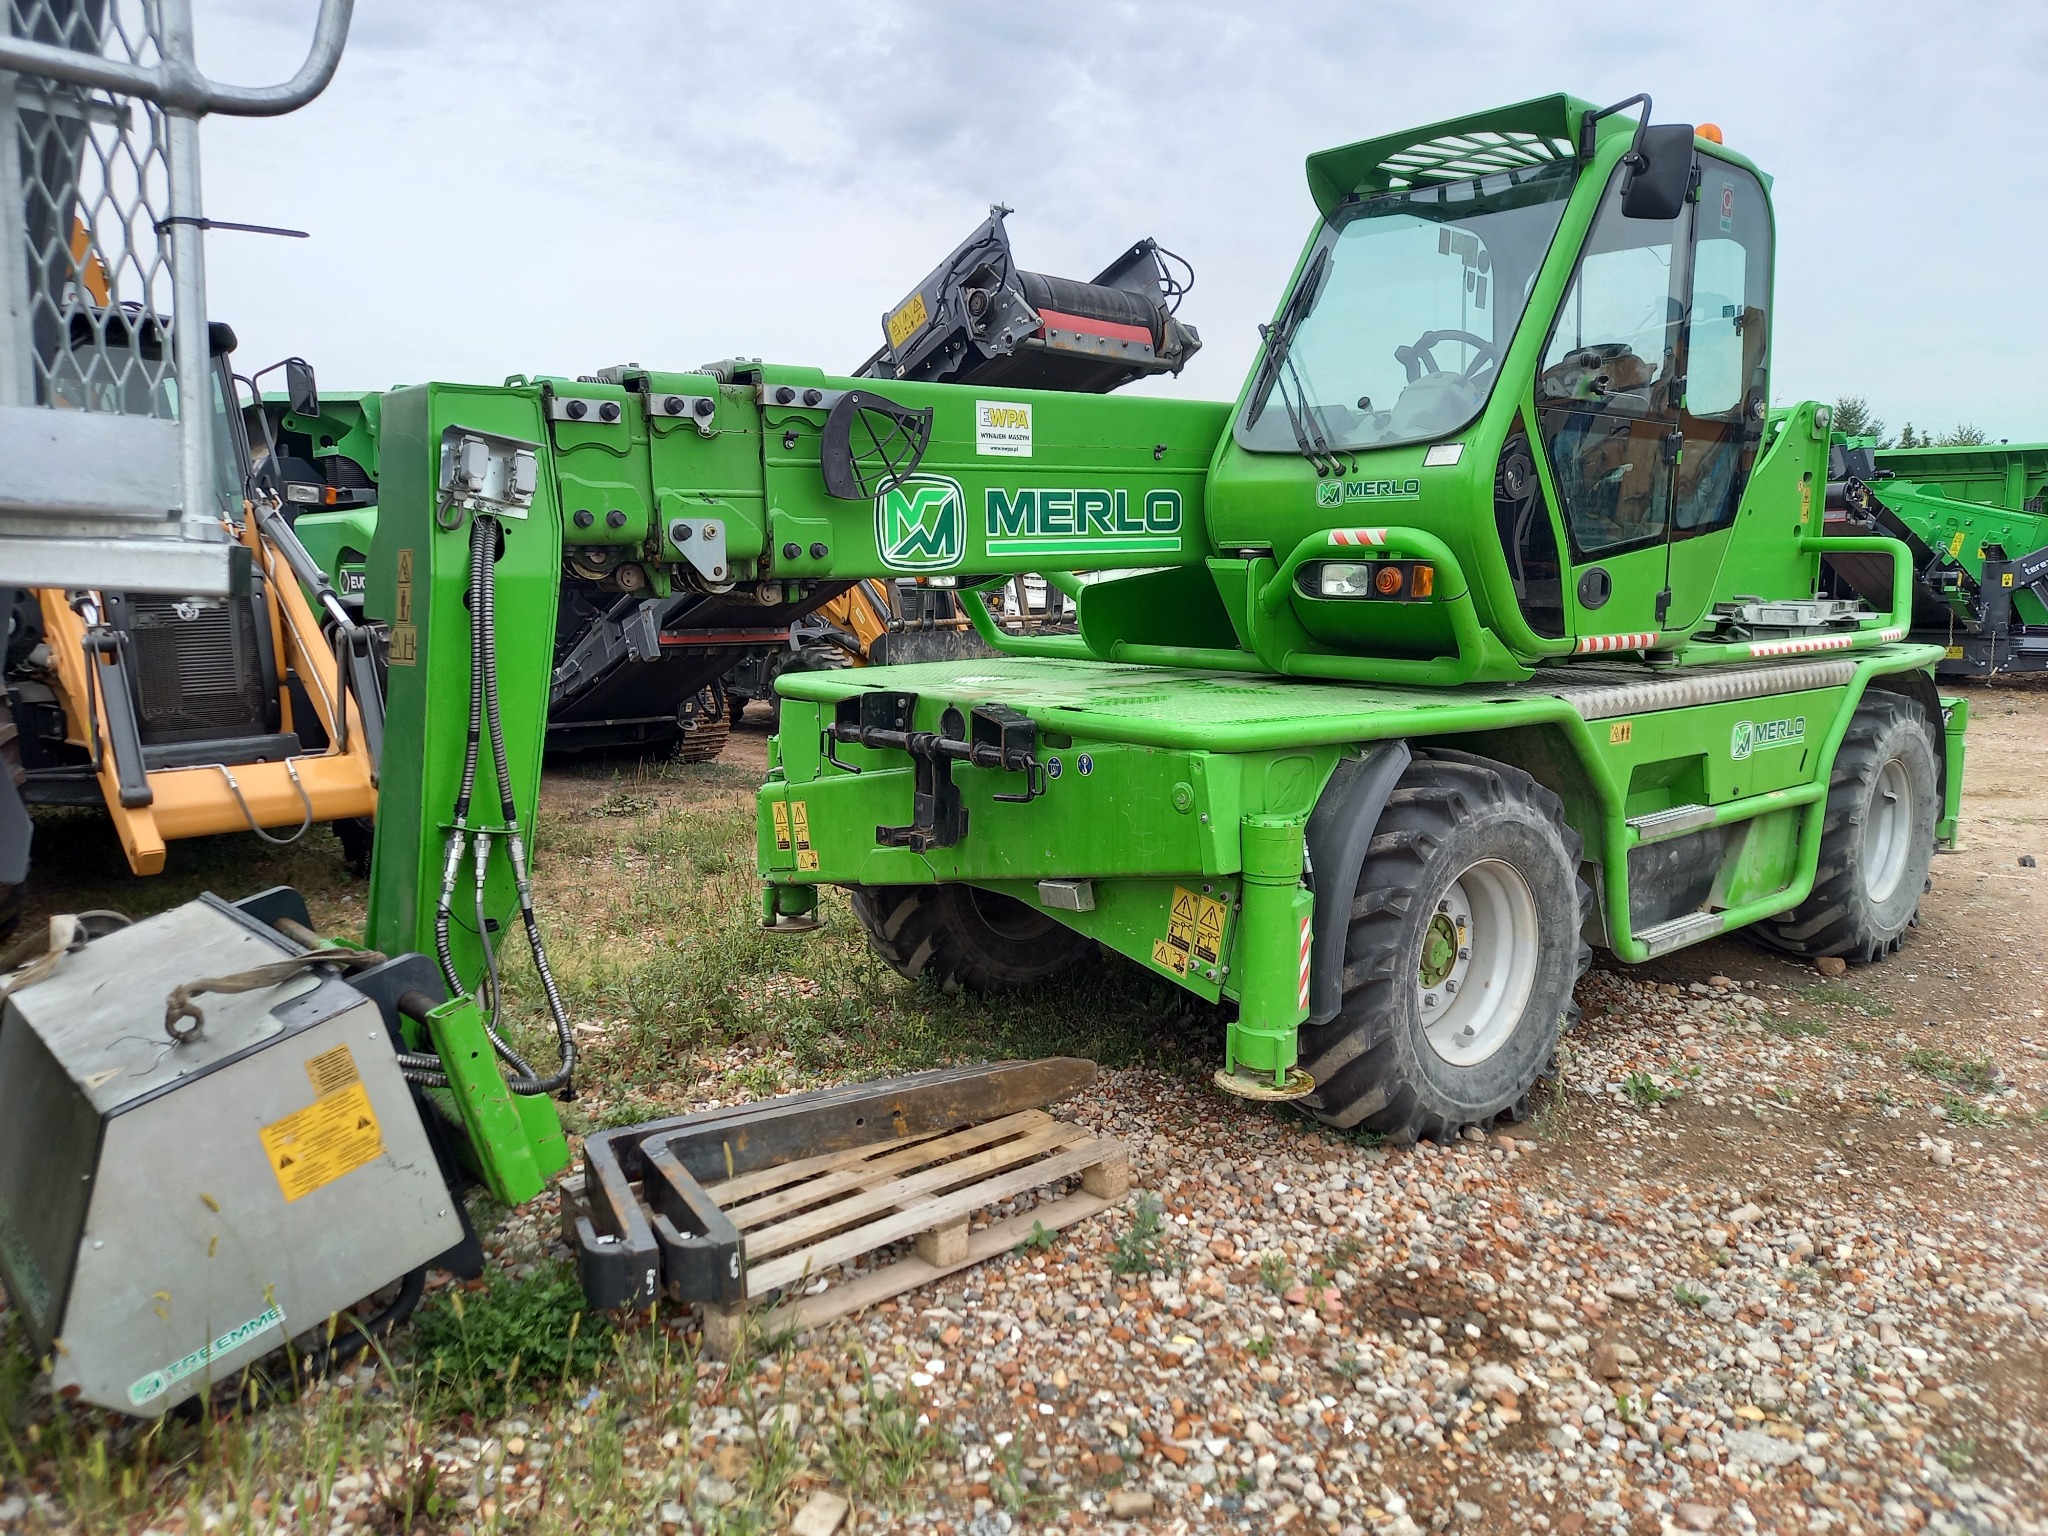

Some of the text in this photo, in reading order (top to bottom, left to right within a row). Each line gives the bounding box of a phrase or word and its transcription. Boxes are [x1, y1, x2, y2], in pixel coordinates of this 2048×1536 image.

[980, 407, 1029, 429] EWPA
[981, 432, 1030, 441] WYNAJEM MASZYN
[1346, 479, 1420, 496] MERLO
[985, 488, 1183, 536] MERLO
[1755, 716, 1805, 743] MERLO
